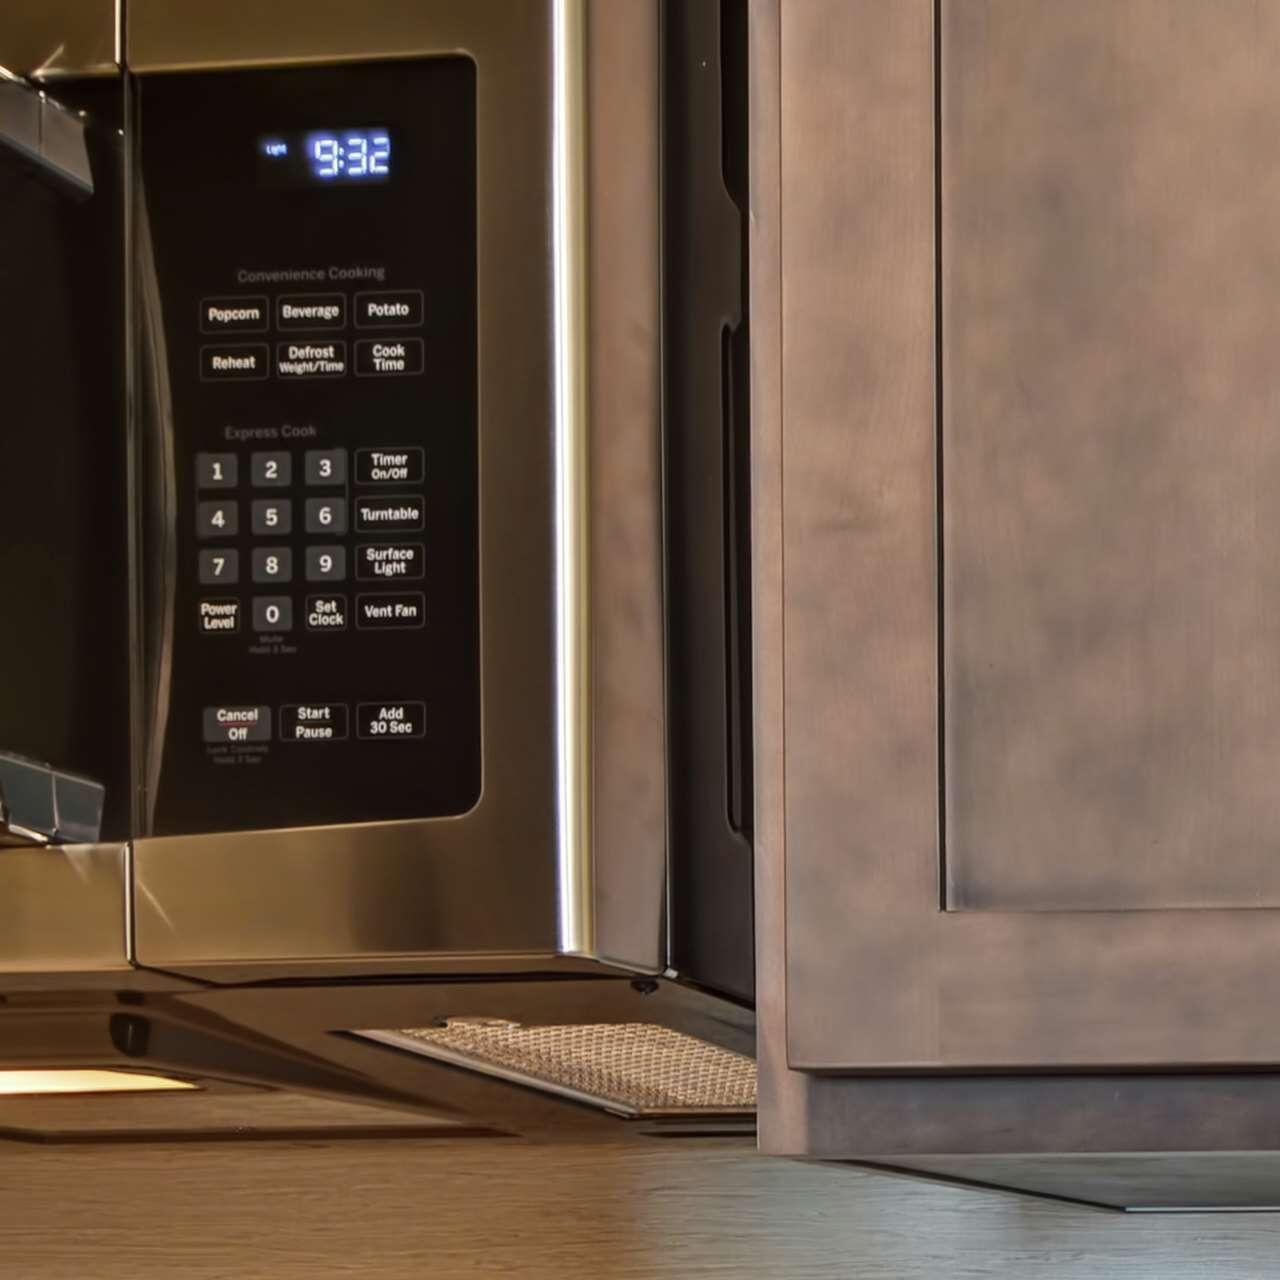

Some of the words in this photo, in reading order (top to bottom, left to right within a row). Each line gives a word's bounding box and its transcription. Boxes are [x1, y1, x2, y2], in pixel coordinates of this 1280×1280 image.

[314, 137, 390, 176] 9:32
[238, 269, 325, 283] Convenience
[328, 266, 385, 281] Cooking
[208, 307, 260, 323] Popcorn
[282, 304, 339, 320] Beverage
[367, 303, 409, 317] Potato
[288, 346, 334, 359] Defrost
[372, 344, 405, 357] Cook
[212, 355, 256, 370] Reheat
[279, 361, 345, 375] Weight/Time
[373, 357, 404, 371] Time
[225, 426, 279, 441] Express
[281, 425, 316, 437] Cook
[371, 452, 408, 466] Timer
[212, 463, 223, 480] 1
[265, 461, 278, 479] 2
[319, 459, 332, 477] 3
[371, 467, 408, 480] On/Off
[211, 510, 225, 527] 4
[265, 508, 278, 526] 5
[319, 506, 332, 524] 6
[360, 507, 419, 521] Turntable
[366, 548, 414, 560] Surface
[212, 558, 225, 576] 7
[266, 556, 279, 574] 8
[319, 555, 332, 572] 9
[374, 561, 407, 576] Light
[201, 603, 237, 616] Power
[315, 600, 337, 612] Set
[364, 605, 392, 618] Vent
[394, 604, 417, 617] Fan
[266, 605, 279, 623] 0
[309, 612, 343, 625] Clock
[204, 616, 234, 630] Level
[217, 709, 258, 722] Cancel
[298, 707, 330, 720] Start
[379, 707, 404, 720] Add
[228, 727, 248, 741] Off
[296, 725, 333, 738] Pause
[370, 721, 387, 734] 30
[389, 721, 412, 734] Sec
